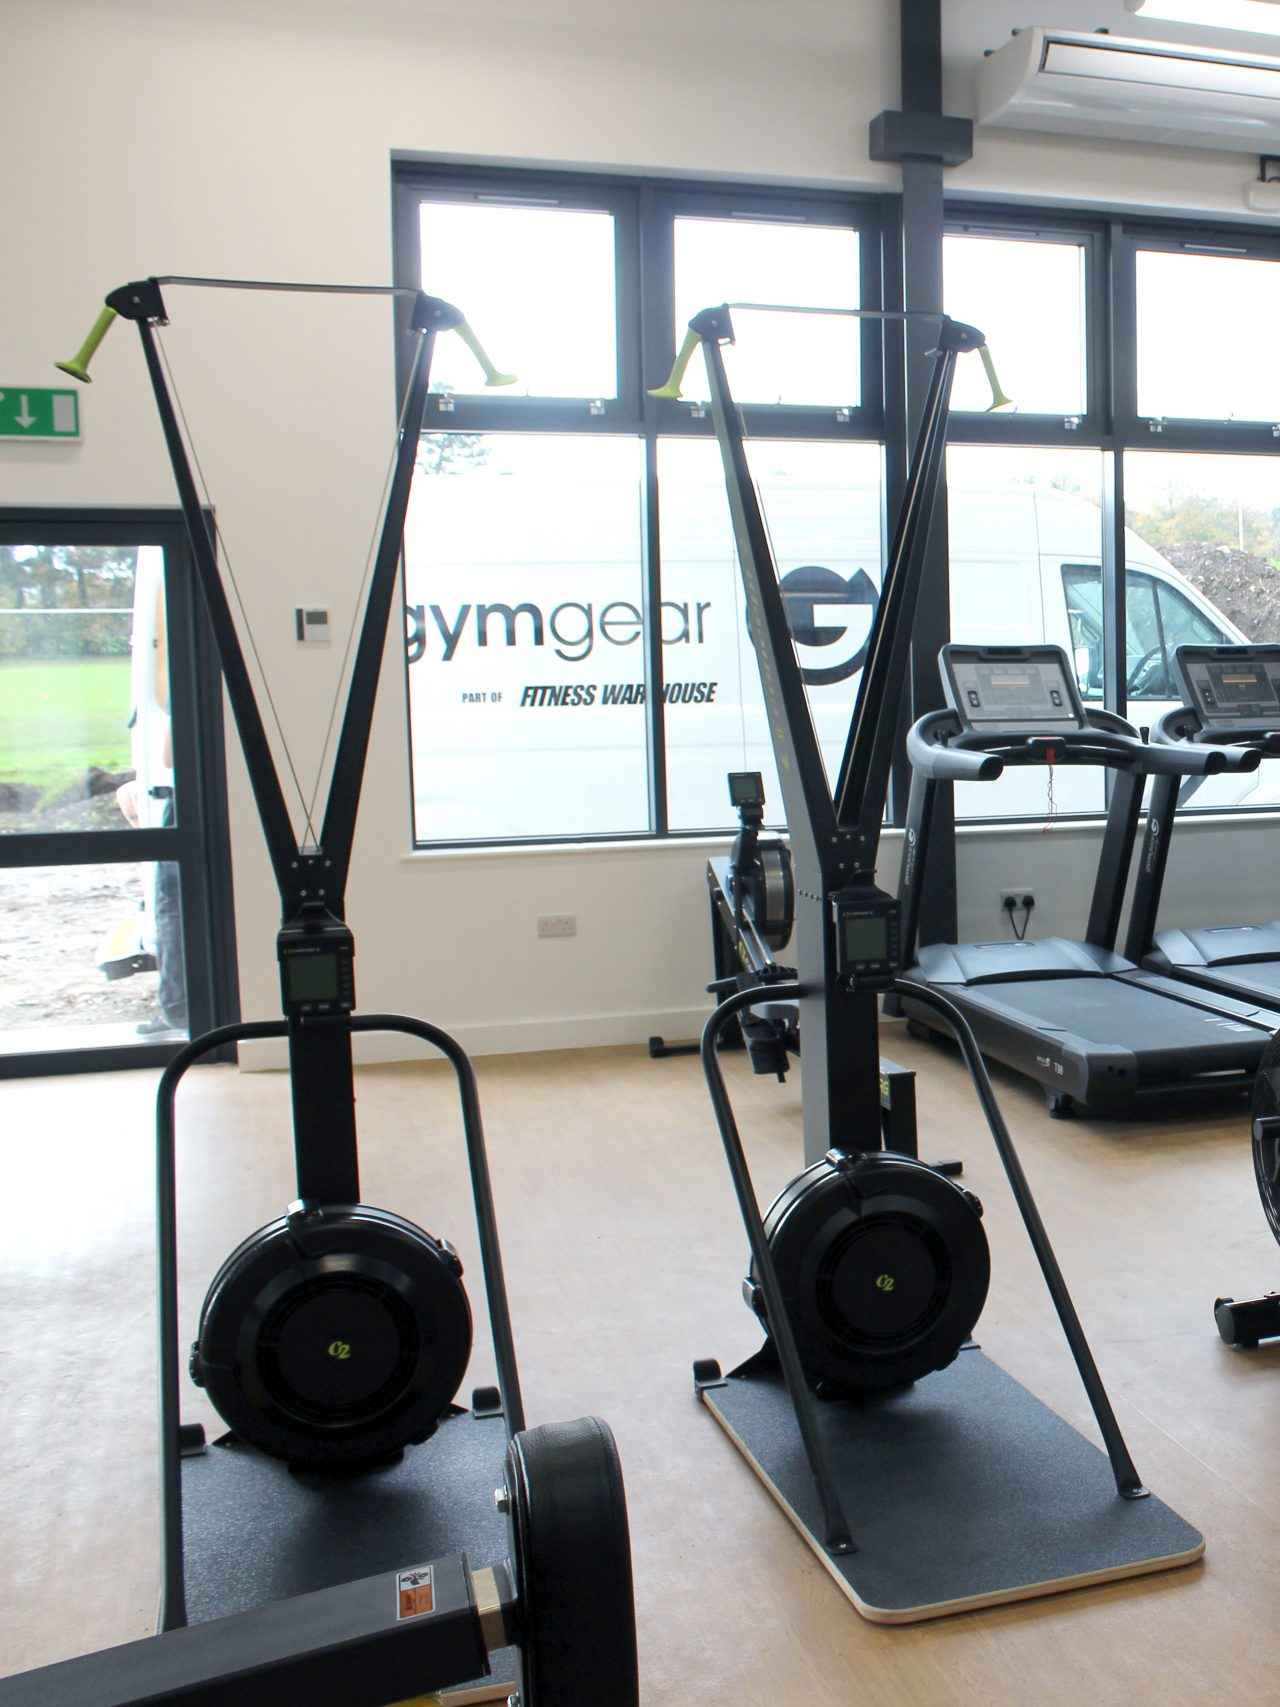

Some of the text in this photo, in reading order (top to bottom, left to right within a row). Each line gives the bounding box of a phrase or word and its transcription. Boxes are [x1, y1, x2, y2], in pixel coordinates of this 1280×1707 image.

[462, 682, 718, 707] PART OF FITNESS WAROUSE
